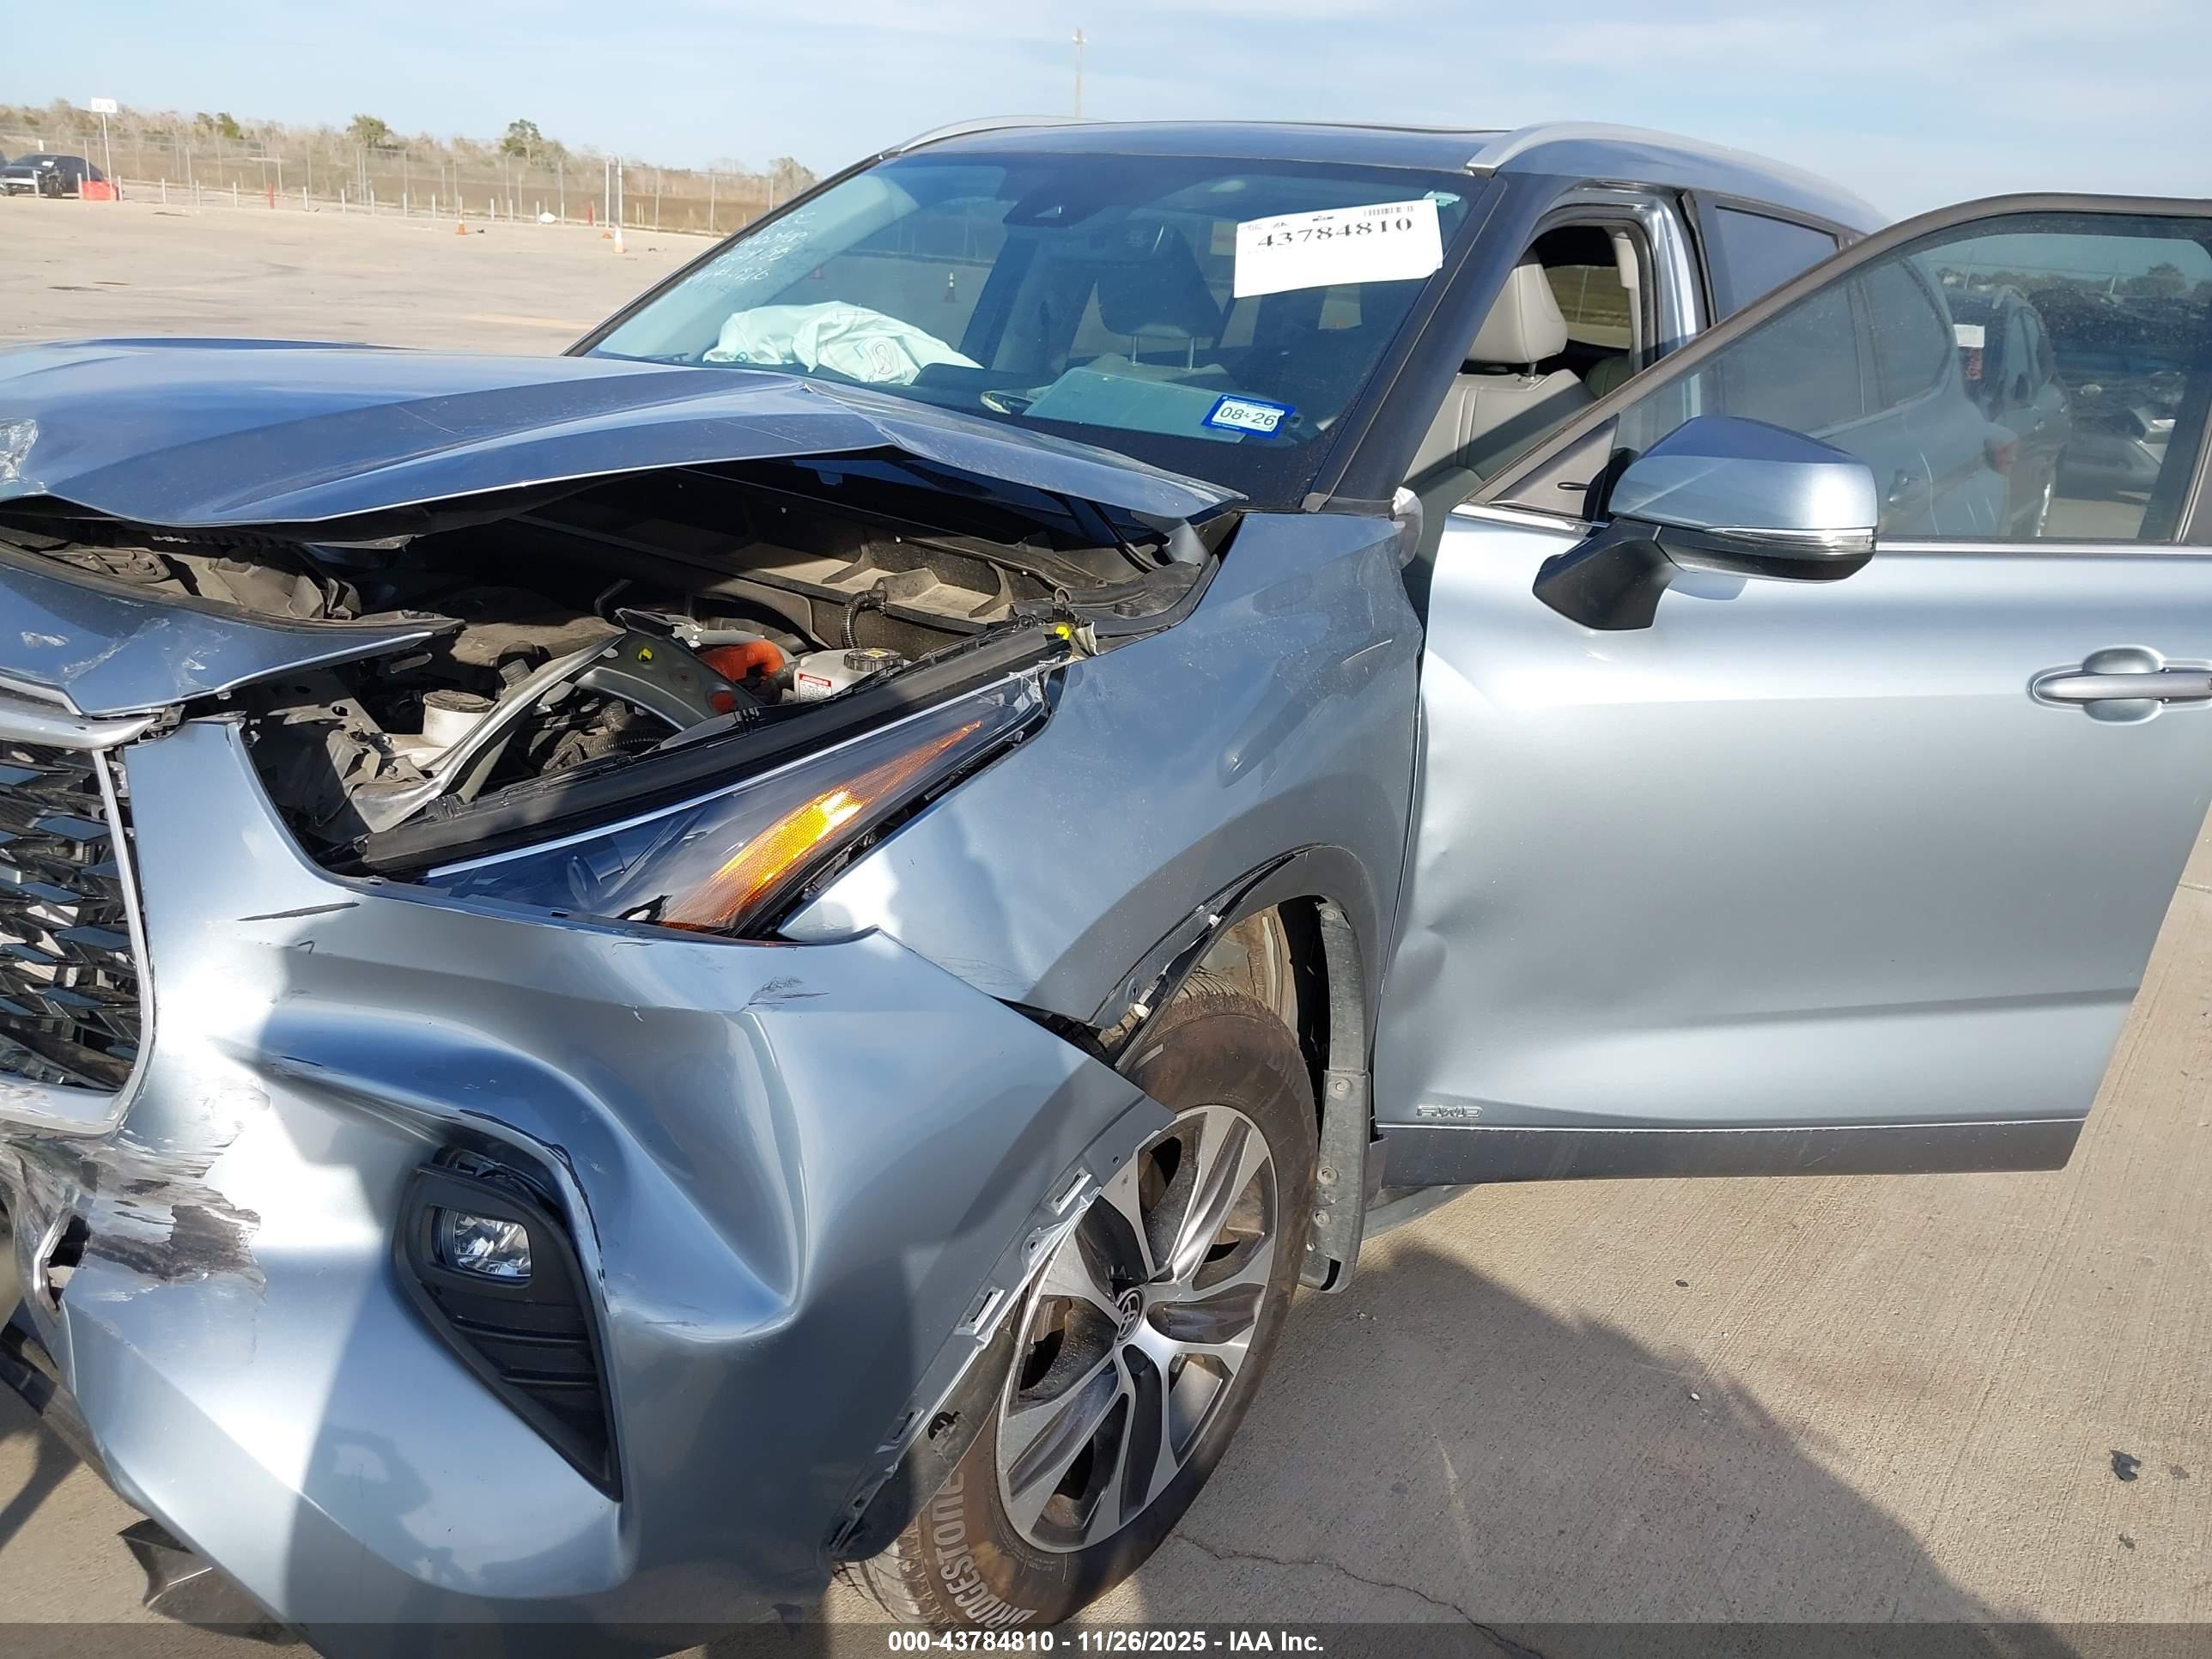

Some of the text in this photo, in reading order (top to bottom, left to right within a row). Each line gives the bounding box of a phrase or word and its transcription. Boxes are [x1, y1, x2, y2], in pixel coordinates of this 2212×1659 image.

[1258, 217, 1413, 247] 43784810
[1220, 406, 1244, 420] 08
[1251, 412, 1277, 426] 26
